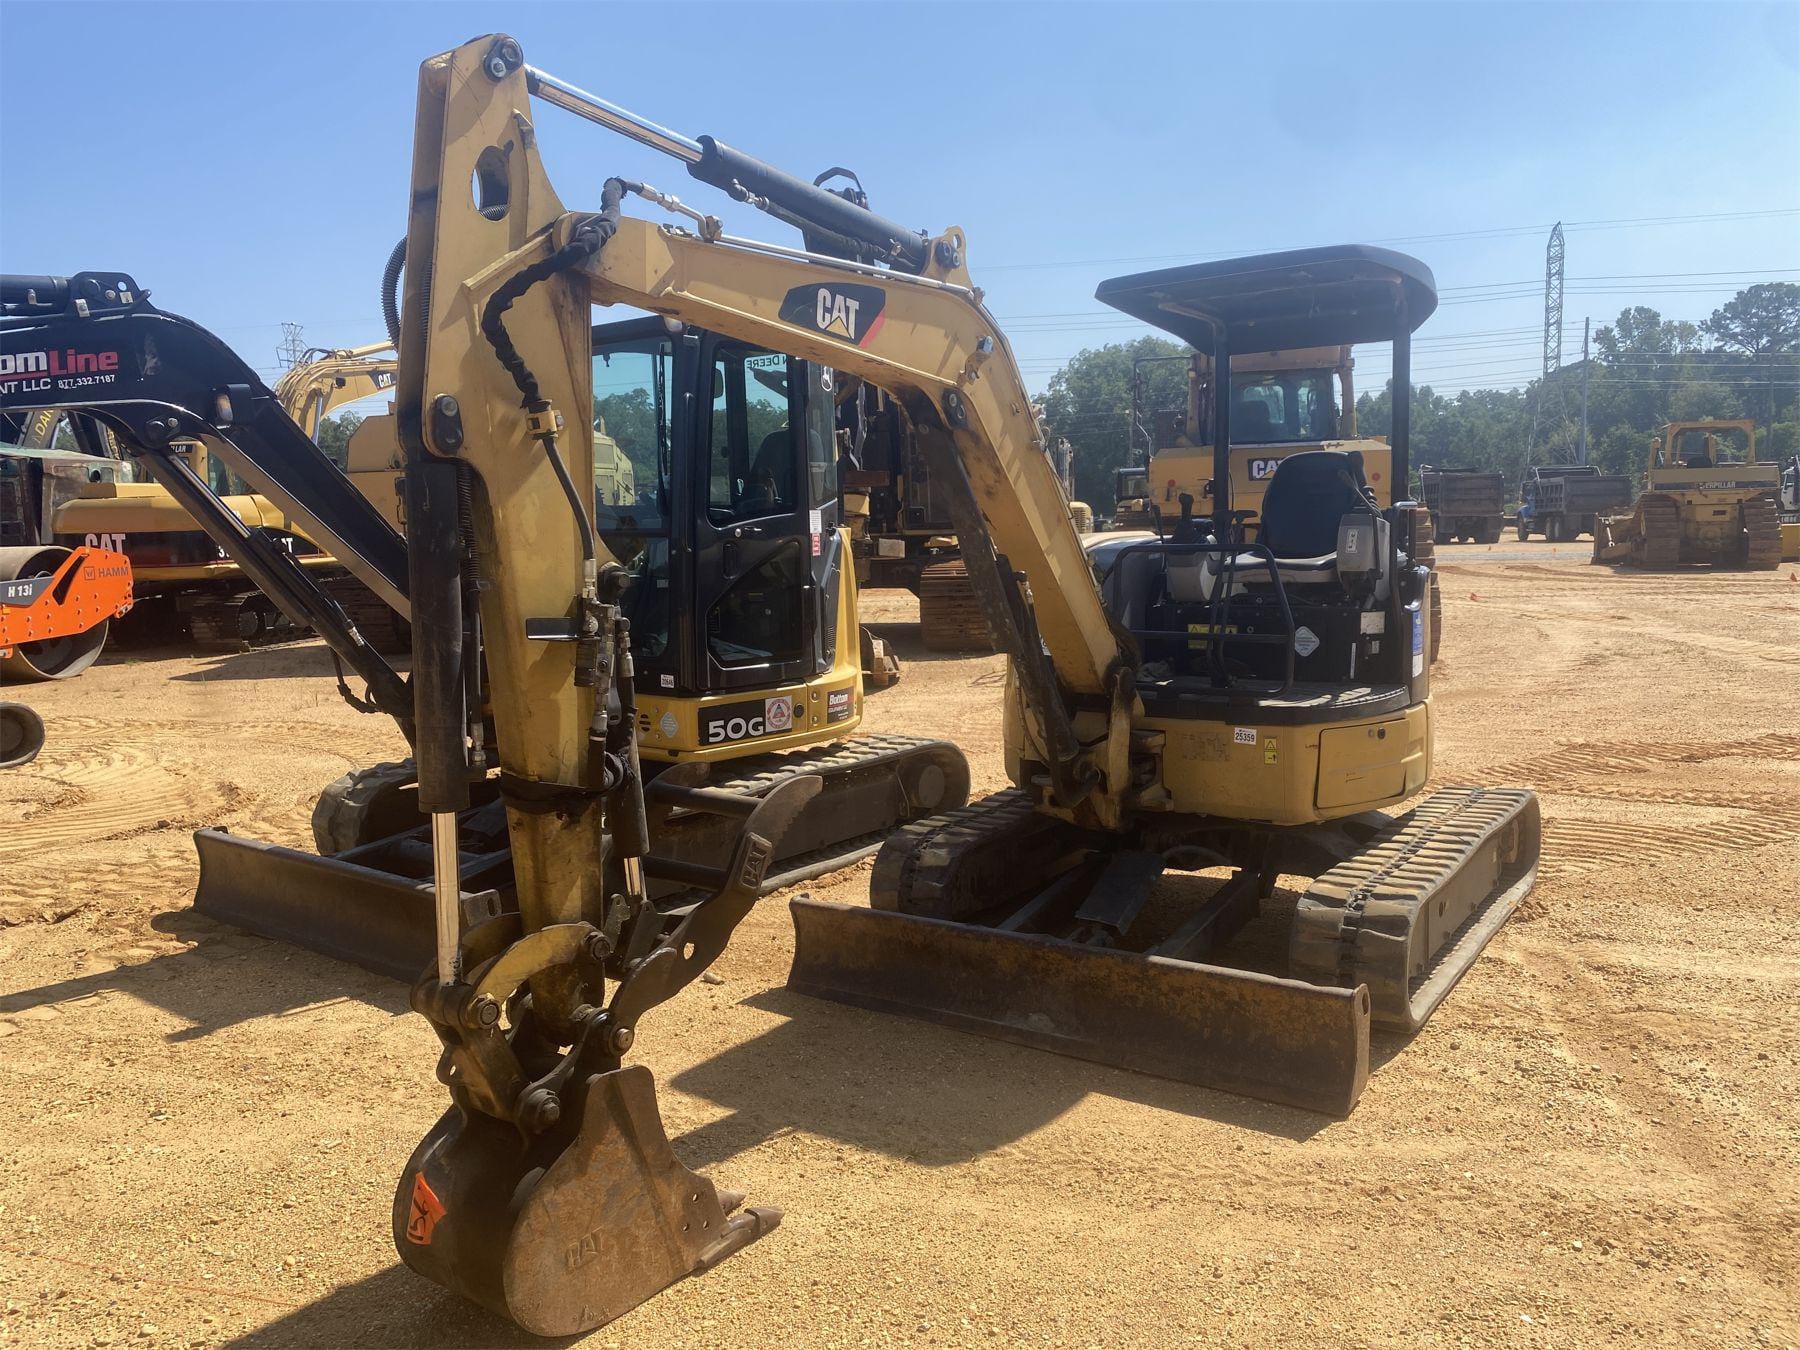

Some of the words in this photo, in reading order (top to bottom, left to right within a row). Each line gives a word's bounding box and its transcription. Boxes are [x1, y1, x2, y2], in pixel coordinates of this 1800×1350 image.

[816, 288, 860, 340] CAT
[22, 378, 51, 392] LLC
[58, 374, 115, 390] 877.332.7187
[378, 373, 392, 388] CAT
[1252, 460, 1281, 479] CA
[98, 567, 129, 577] HAMM
[8, 586, 15, 597] H
[17, 584, 32, 597] 13i
[708, 717, 764, 742] 50G
[1235, 732, 1255, 742] 25359
[565, 1225, 605, 1270] CAT
